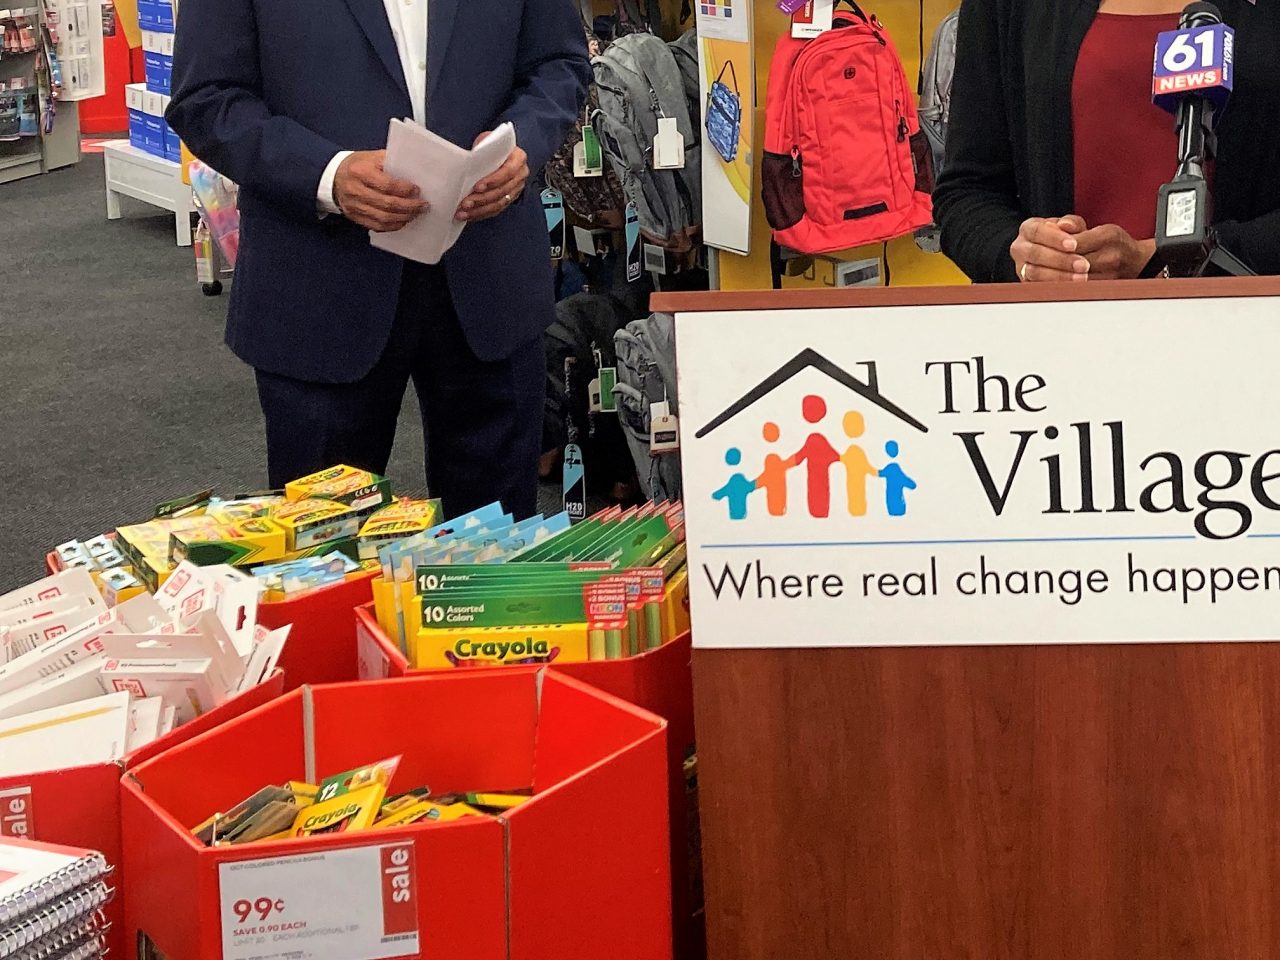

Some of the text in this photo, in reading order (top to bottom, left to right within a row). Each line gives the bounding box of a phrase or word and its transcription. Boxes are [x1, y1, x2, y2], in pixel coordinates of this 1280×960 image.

[1163, 30, 1215, 73] 61
[1160, 70, 1217, 90] NEWS
[924, 355, 1047, 415] The
[417, 574, 438, 590] 10
[702, 558, 844, 602] Where
[861, 556, 937, 597] real
[956, 554, 1110, 606] change
[423, 603, 485, 623] 10 Assorted
[447, 612, 474, 623] Colors
[454, 636, 549, 662] Crayola
[321, 783, 338, 800] 12
[4, 798, 28, 839] ale
[304, 802, 358, 829] Crayola
[385, 848, 411, 903] sale
[233, 897, 286, 923] 99¢
[233, 922, 307, 936] SAVE 0.90 EACH
